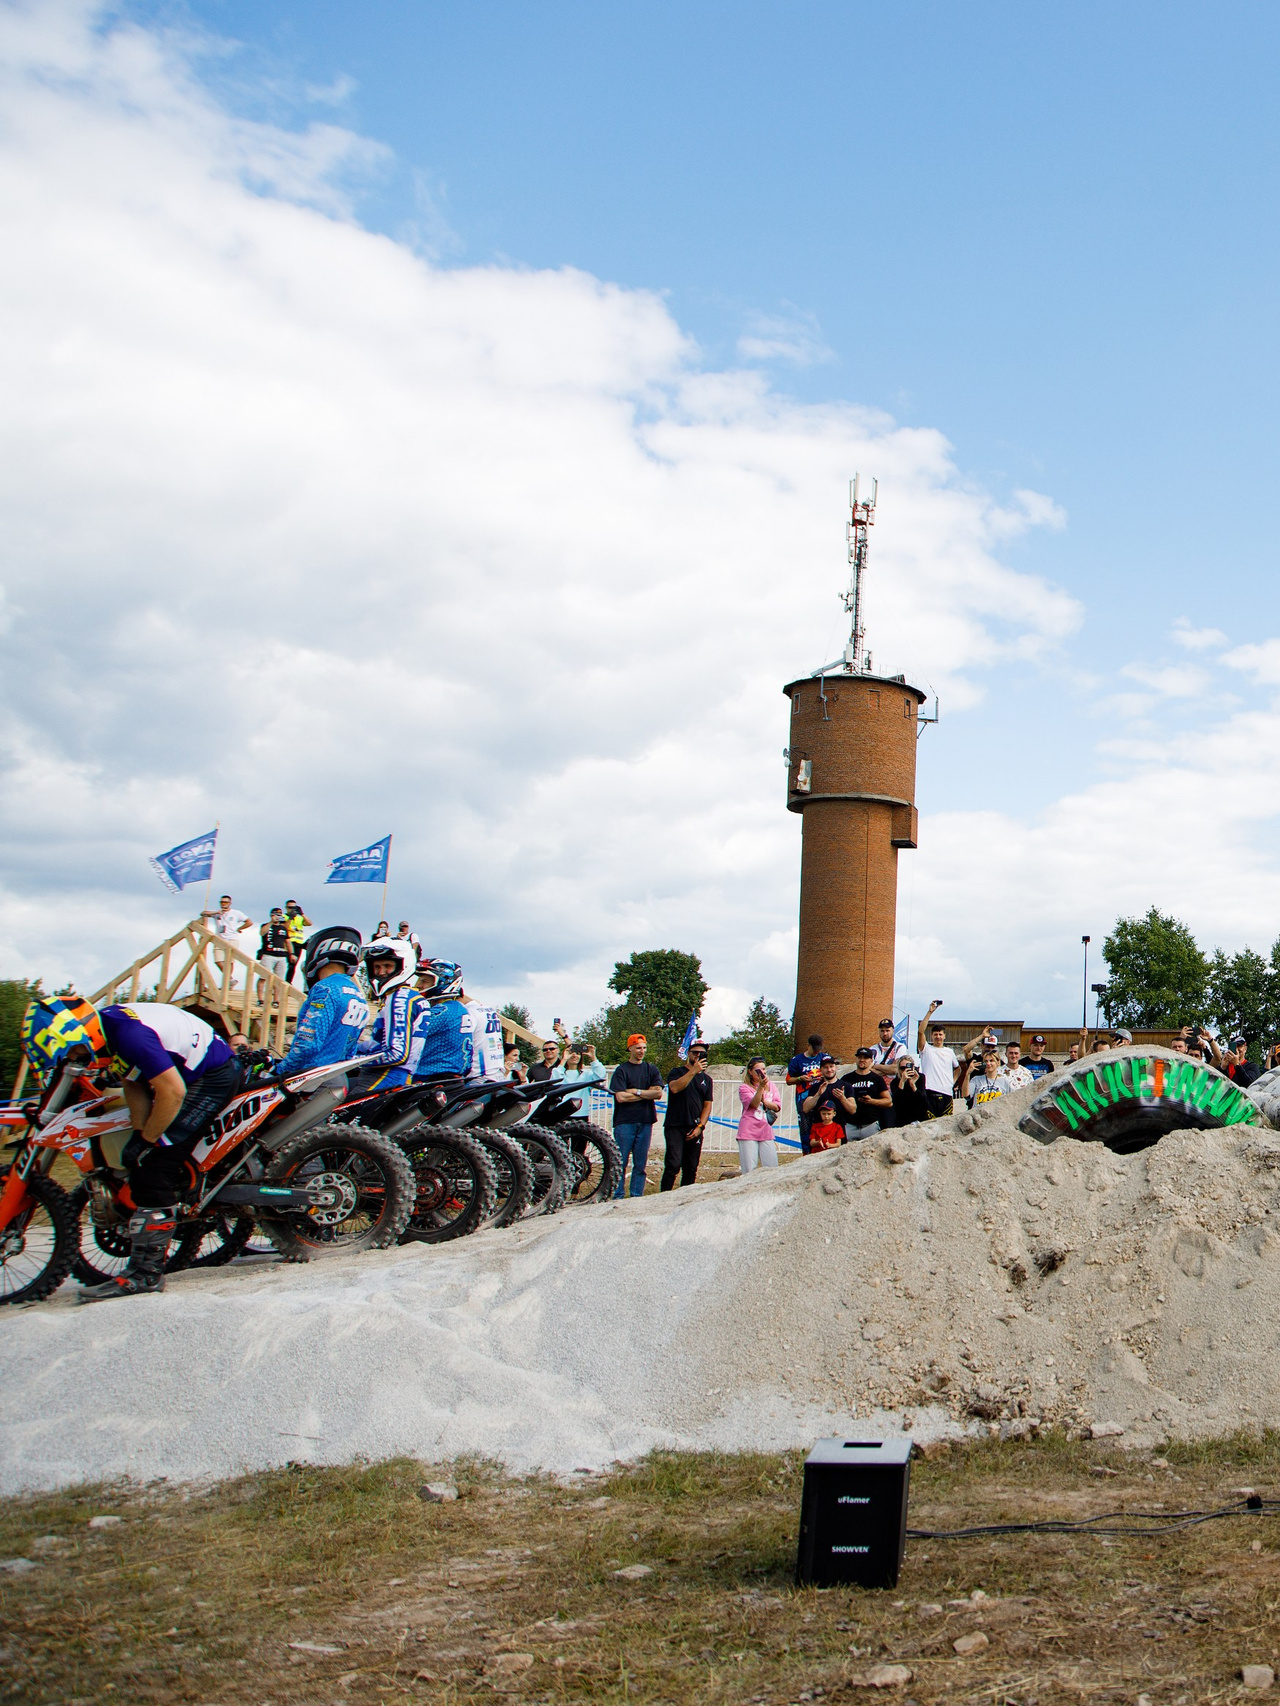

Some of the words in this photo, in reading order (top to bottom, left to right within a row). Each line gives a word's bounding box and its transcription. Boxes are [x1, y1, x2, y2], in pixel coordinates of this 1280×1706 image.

[394, 998, 407, 1029] TEAM
[838, 1496, 870, 1504] uFlamer
[832, 1545, 869, 1553] SHOWVEN
